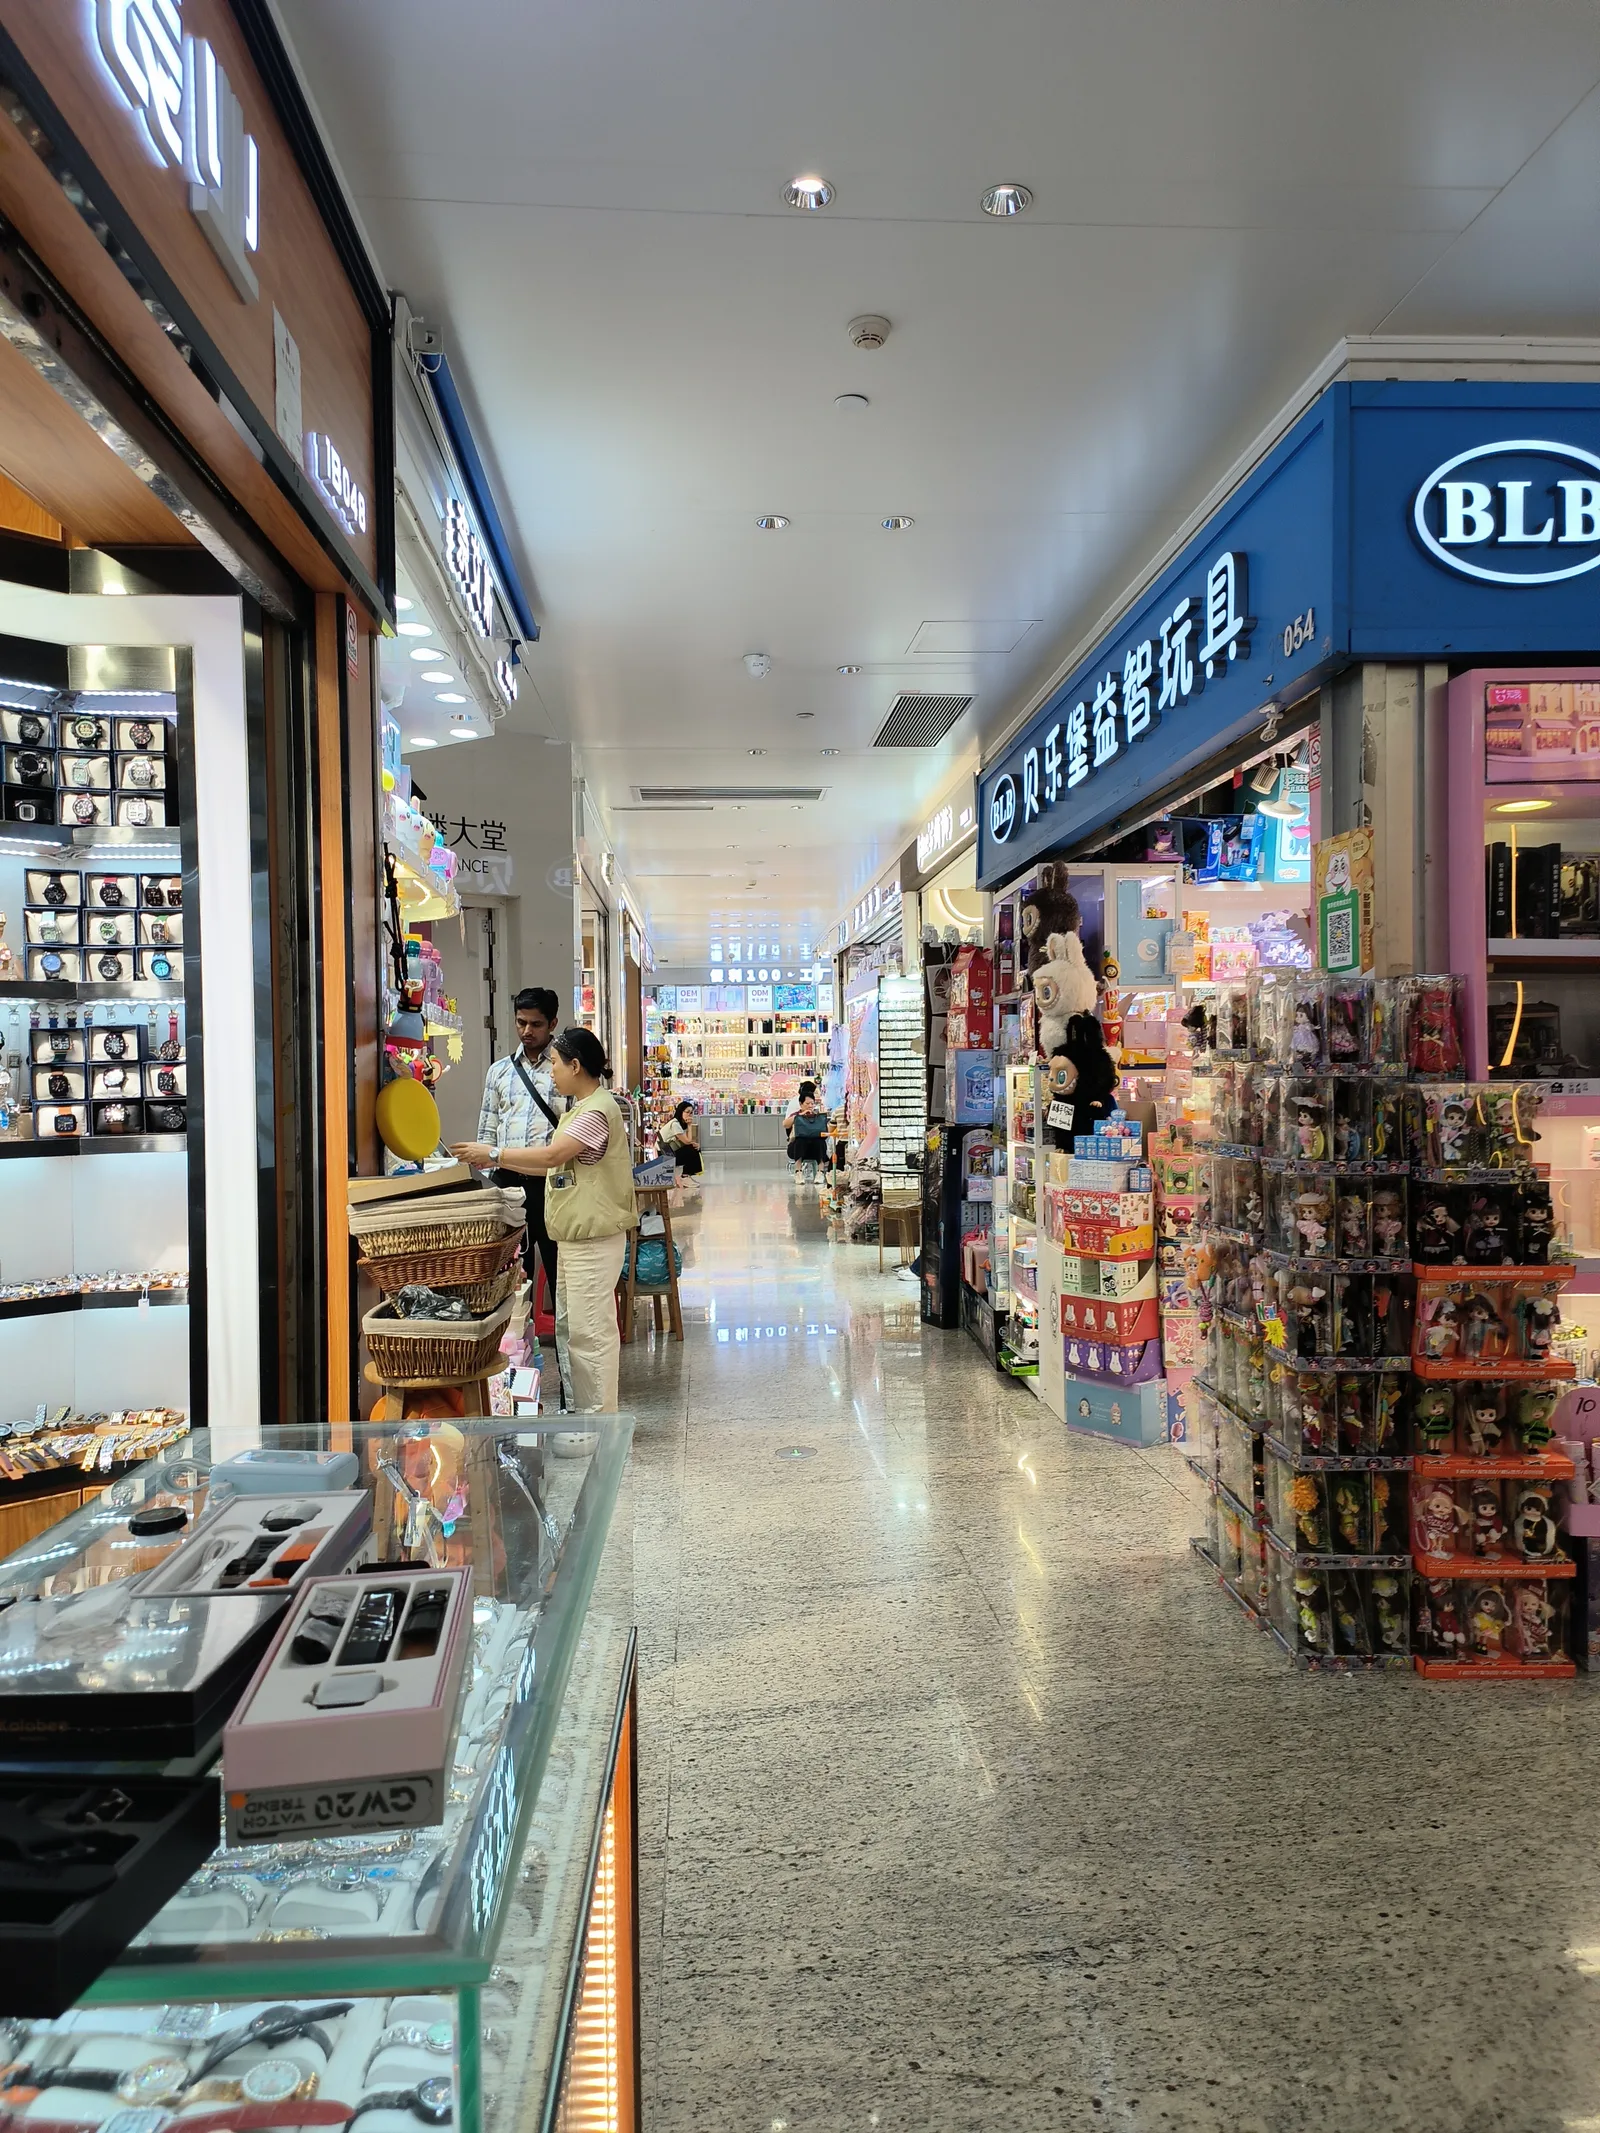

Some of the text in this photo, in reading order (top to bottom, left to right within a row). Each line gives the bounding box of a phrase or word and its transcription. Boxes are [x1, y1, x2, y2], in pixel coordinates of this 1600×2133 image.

[1438, 479, 1600, 544] BLB
[1283, 607, 1316, 658] 054
[1022, 551, 1245, 824] 贝乐堡益智玩具
[992, 787, 1016, 834] BLB
[680, 989, 698, 997] OEM
[751, 989, 769, 997] ODM
[243, 1812, 306, 1829] WATCH
[244, 1796, 306, 1814] TREND
[314, 1785, 417, 1821] GW20
